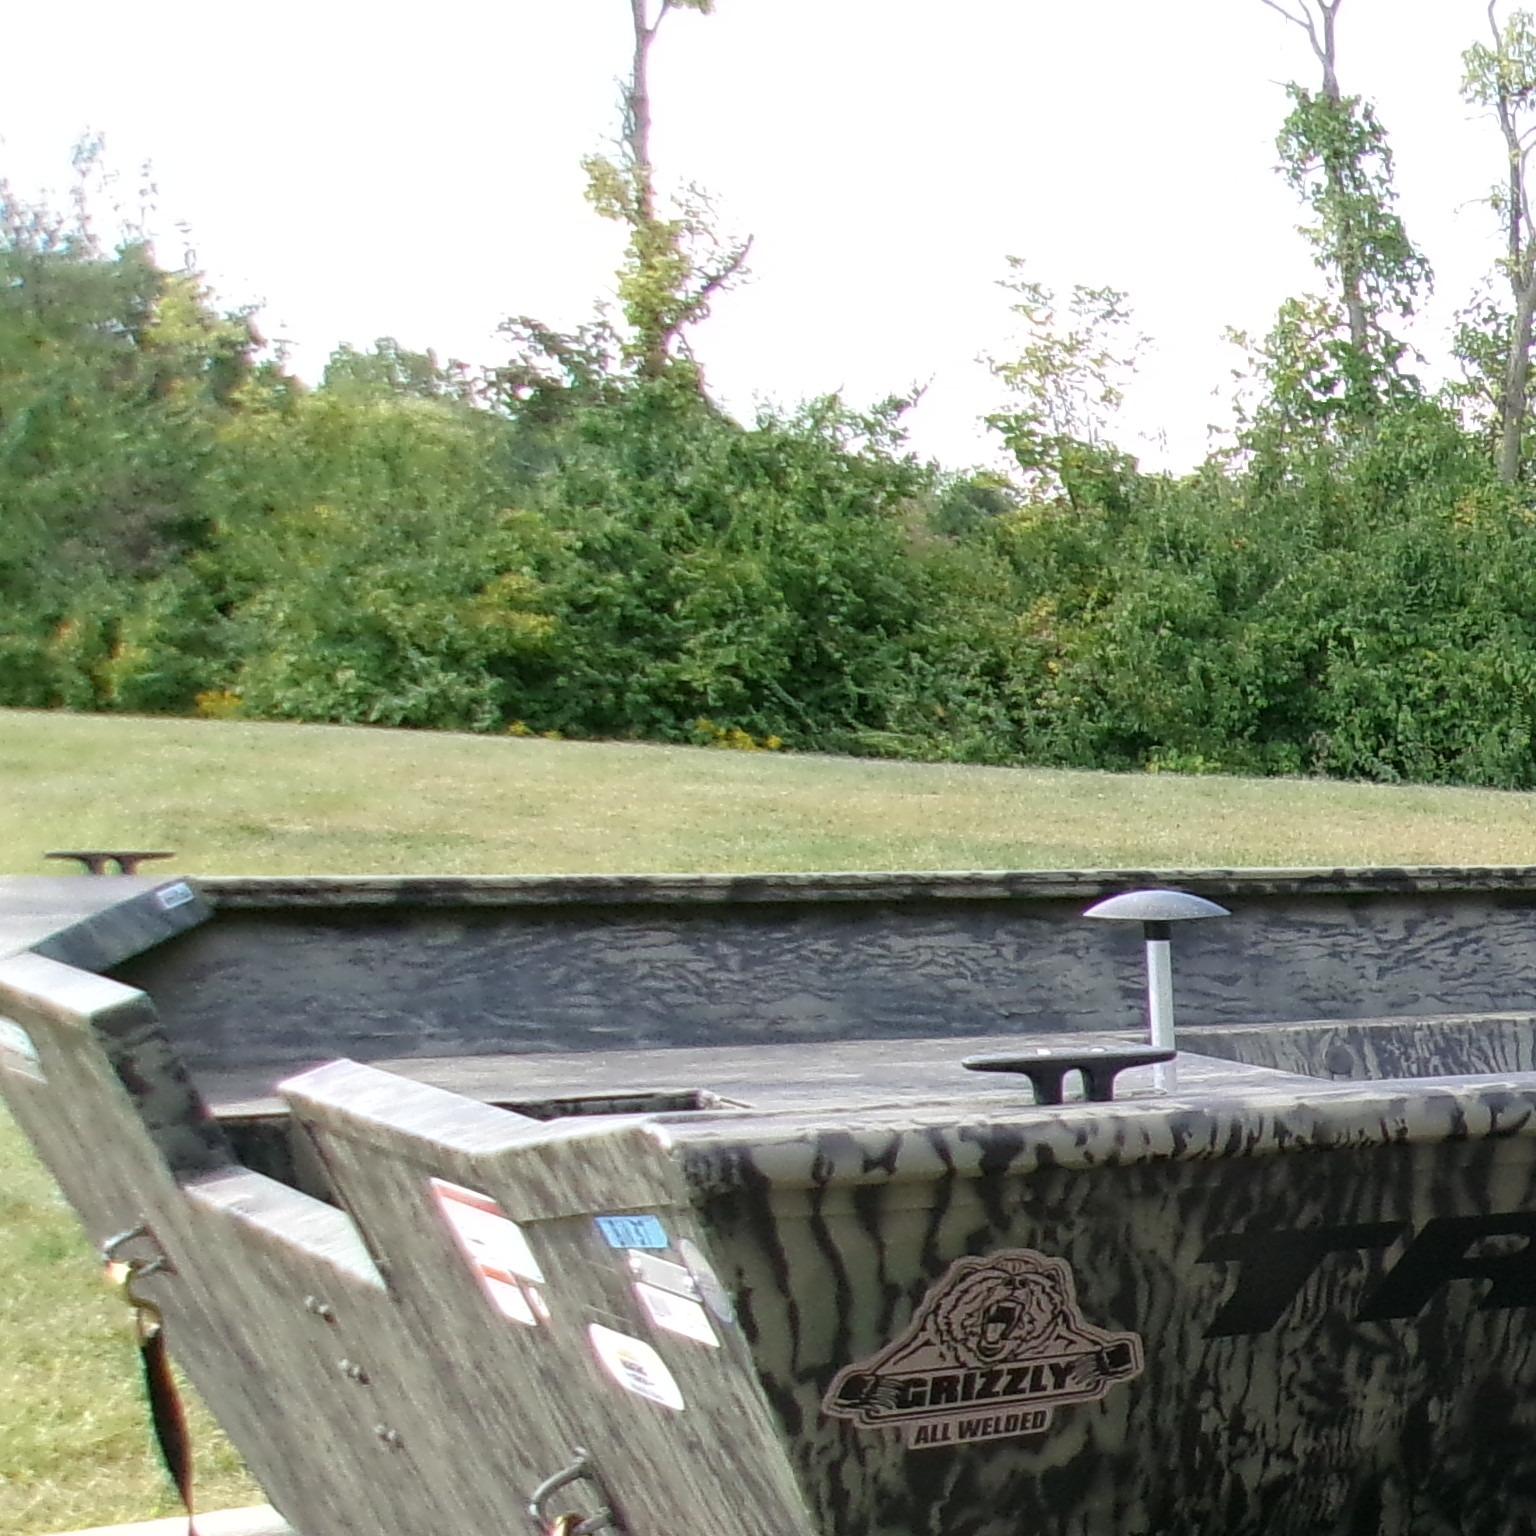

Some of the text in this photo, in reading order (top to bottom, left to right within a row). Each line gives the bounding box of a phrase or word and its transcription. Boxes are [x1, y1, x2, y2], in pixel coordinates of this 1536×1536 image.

[899, 1359, 1077, 1409] GRIZZLY
[914, 1410, 1047, 1446] ALL WELDED
